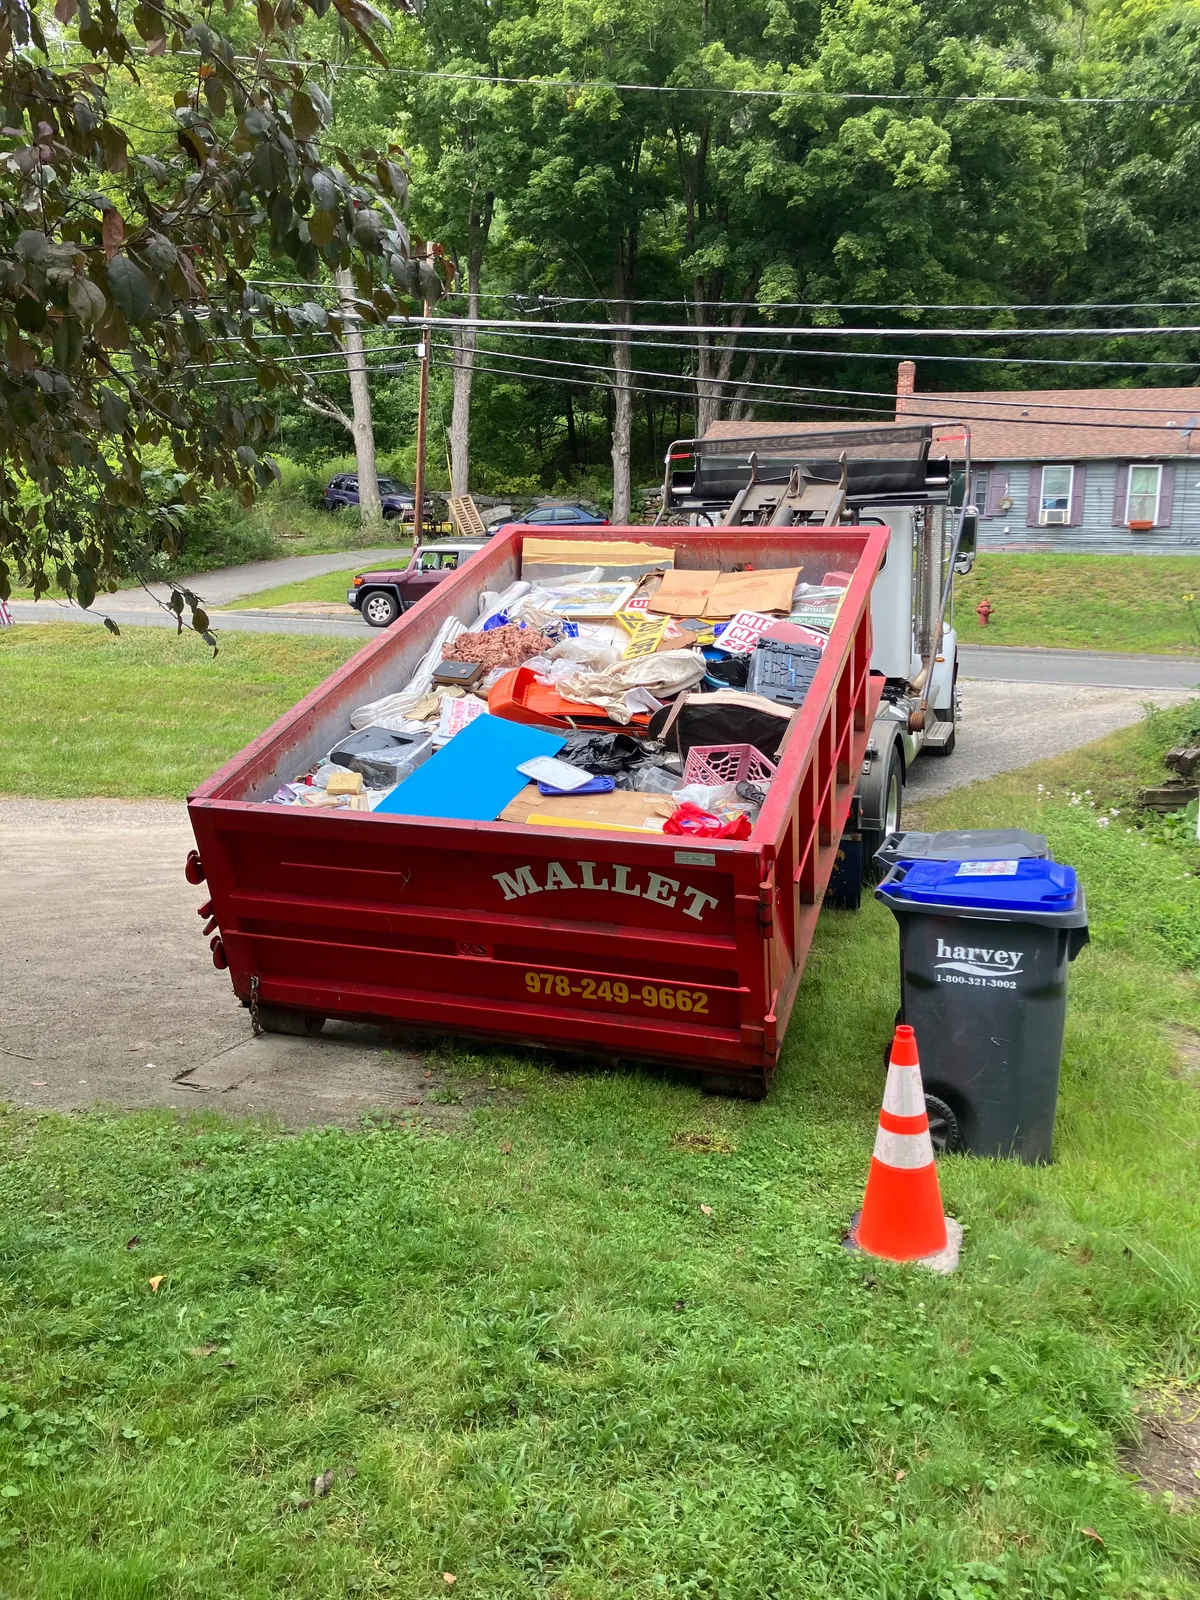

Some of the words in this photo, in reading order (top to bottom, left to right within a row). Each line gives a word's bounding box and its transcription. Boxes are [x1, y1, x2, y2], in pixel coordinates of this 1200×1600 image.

[492, 861, 719, 921] MALLET
[936, 938, 1023, 970] harvey
[524, 972, 709, 1014] 978-249-9662
[936, 974, 1017, 989] 1-800-321-3002
